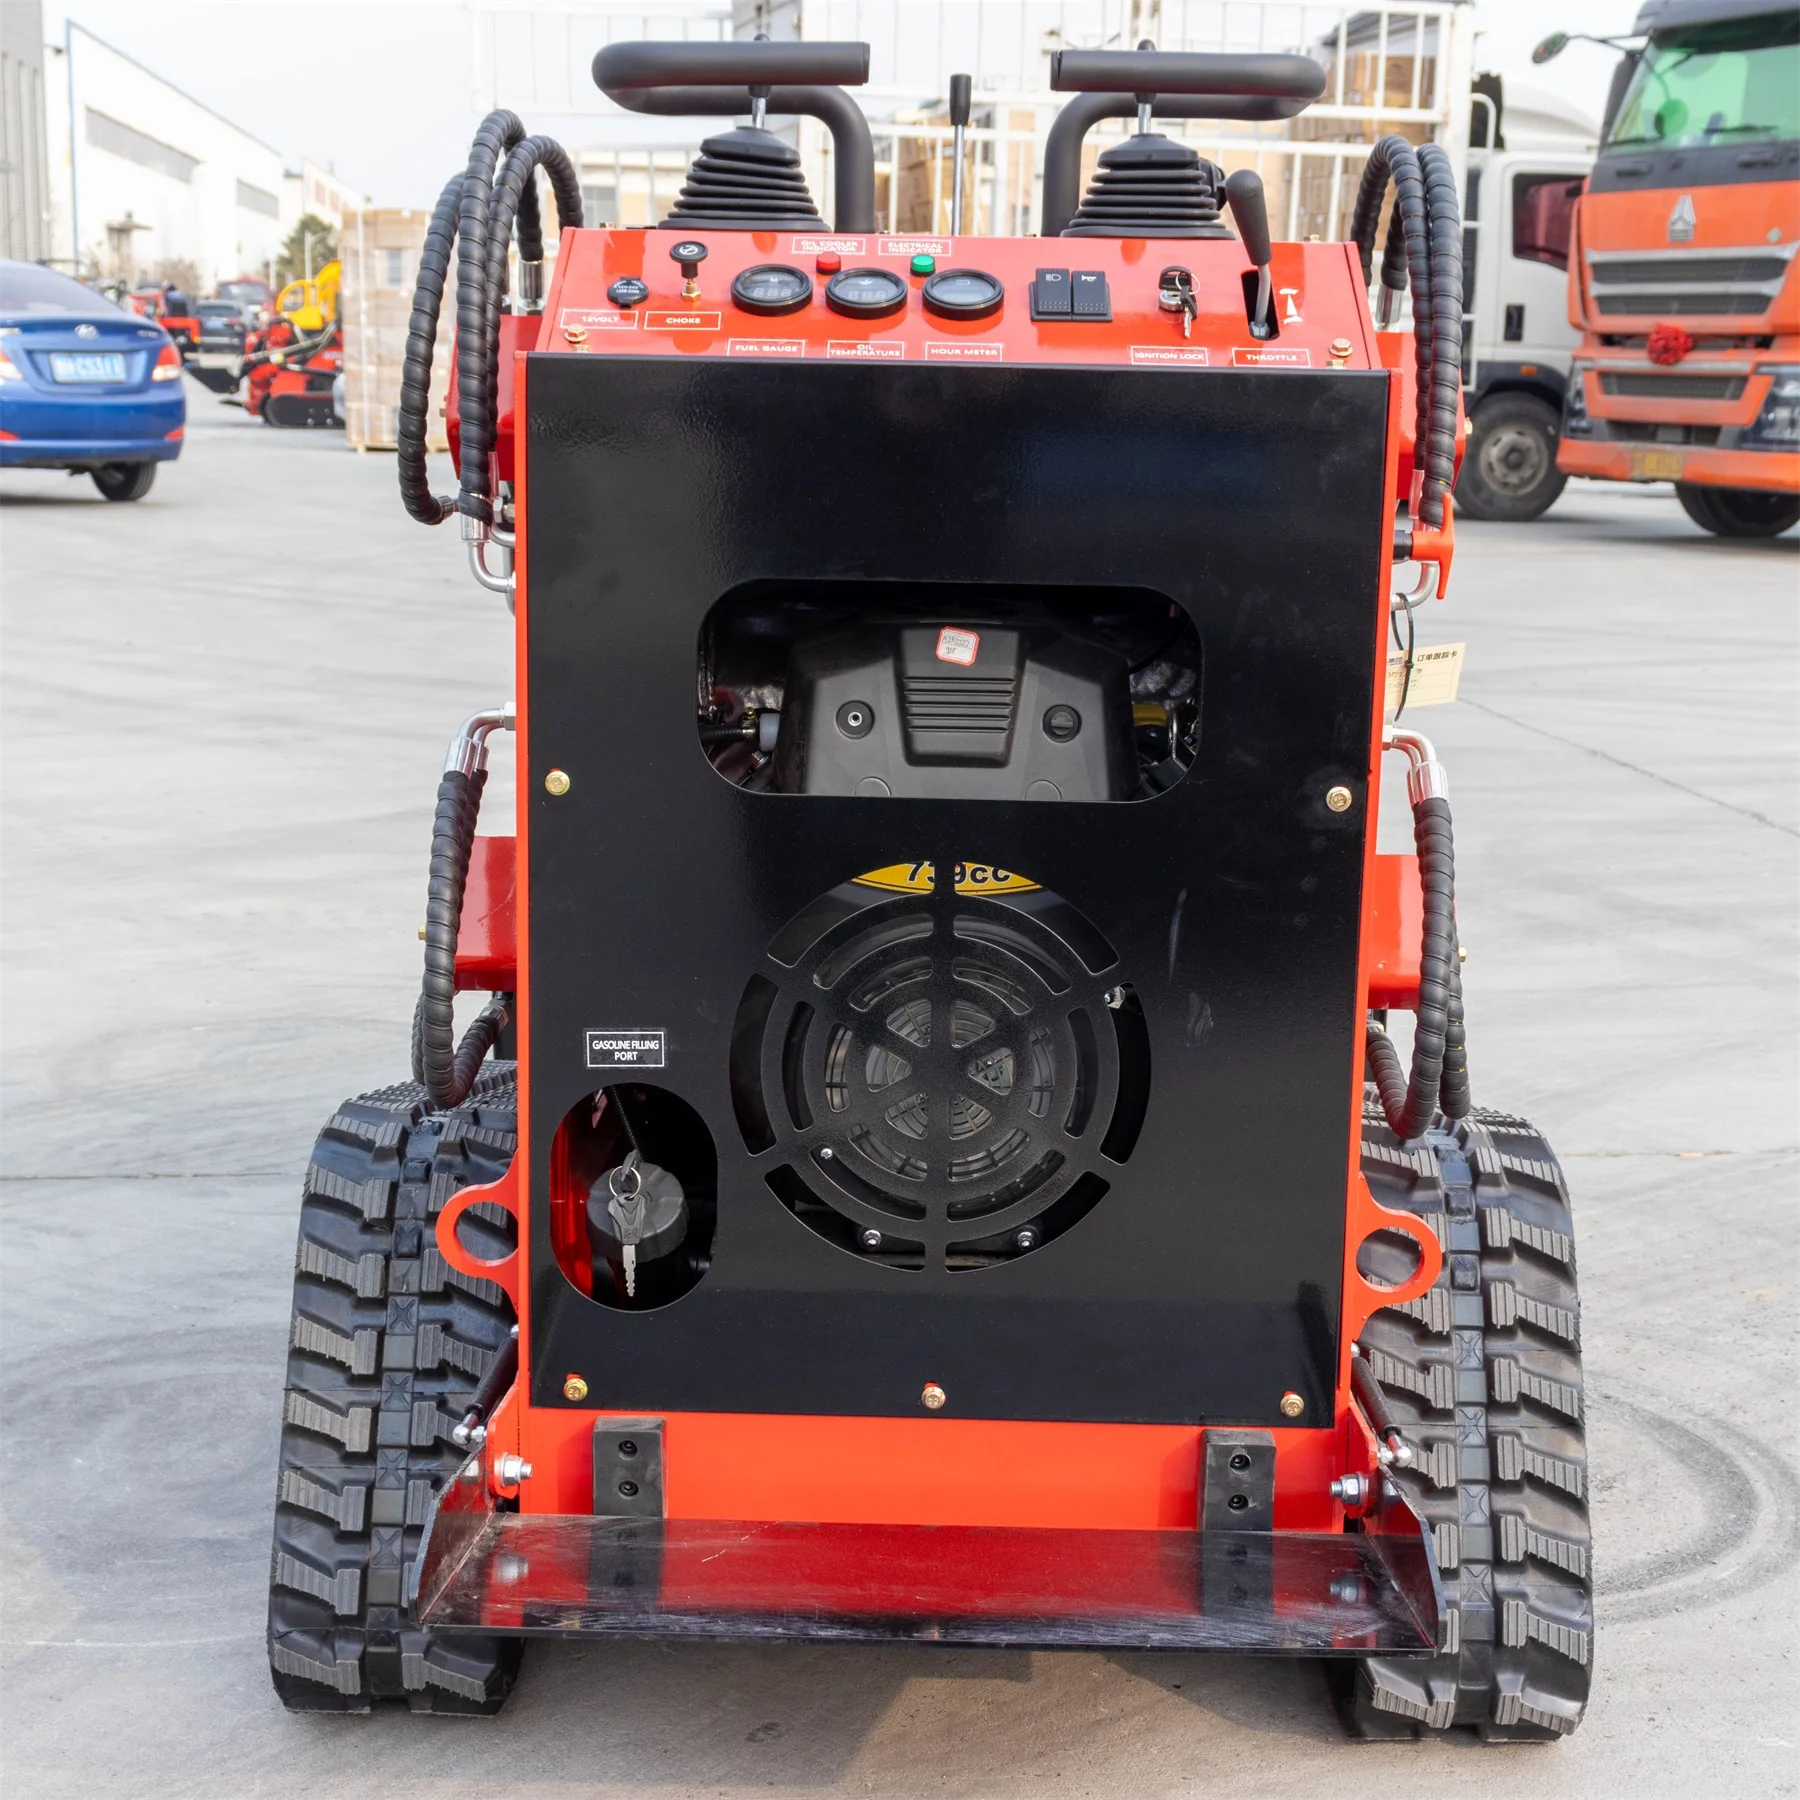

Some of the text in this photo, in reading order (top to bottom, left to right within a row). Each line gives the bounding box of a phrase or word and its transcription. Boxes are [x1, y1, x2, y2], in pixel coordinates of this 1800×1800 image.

[820, 240, 858, 248] COOLER
[735, 344, 798, 353] FUEL GAUGE
[830, 349, 900, 357] TEMPERATURE
[1135, 352, 1177, 360] IGNITION
[1246, 354, 1298, 362] THROTTLE
[592, 1040, 659, 1050] GASOLINE FILLING
[614, 1051, 638, 1061] PORT
